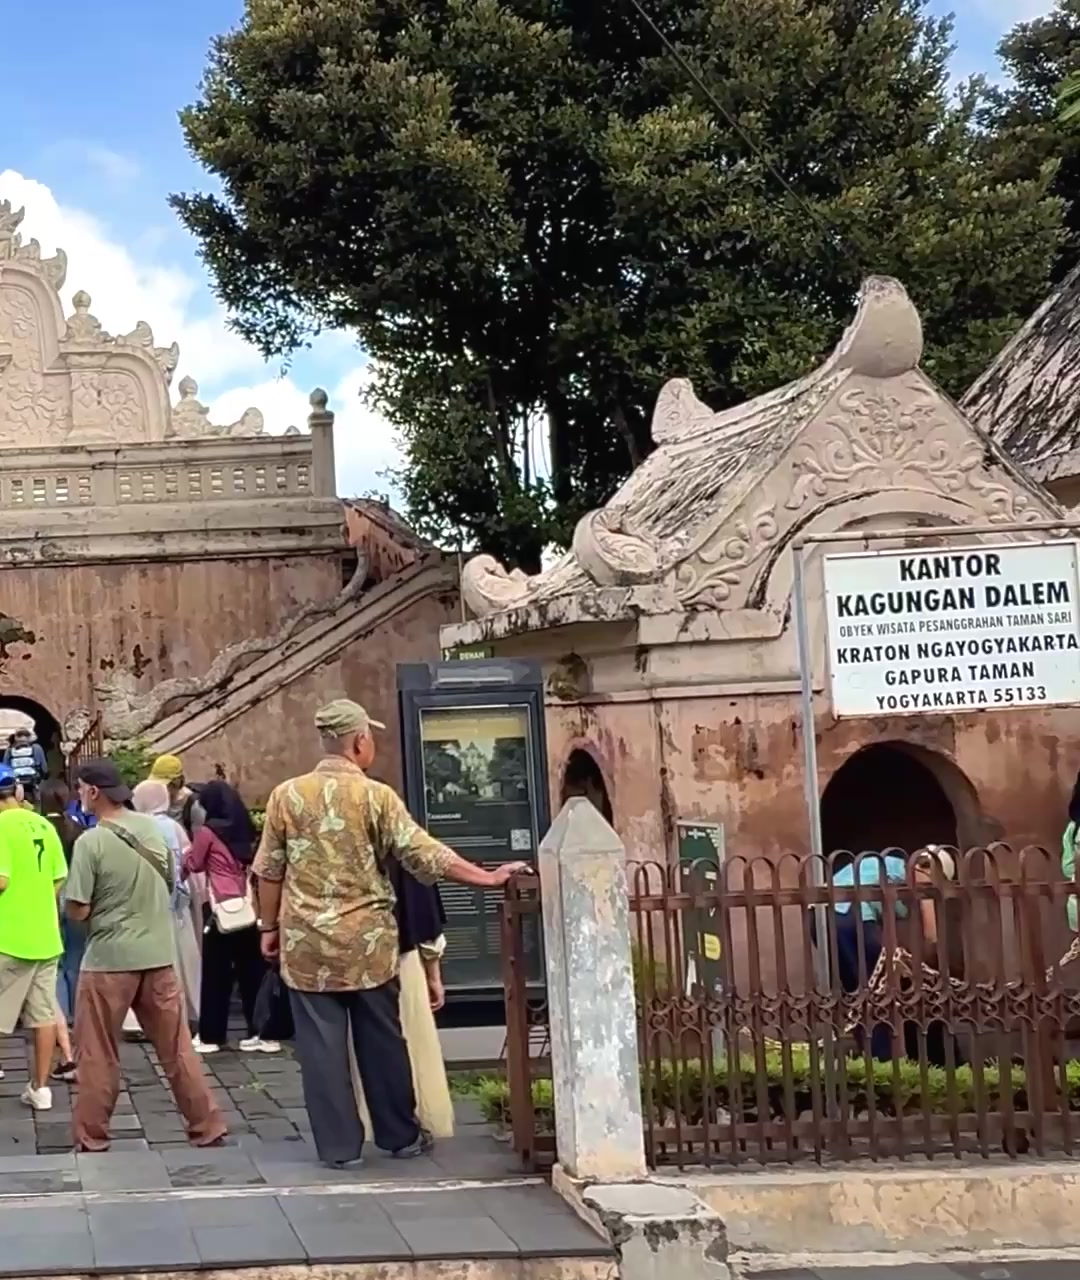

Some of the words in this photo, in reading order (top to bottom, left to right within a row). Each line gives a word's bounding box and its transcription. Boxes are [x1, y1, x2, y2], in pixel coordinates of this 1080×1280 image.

[900, 553, 1002, 581] KANTOR
[836, 587, 976, 618] KAGUNGAN
[985, 580, 1071, 608] DALEM
[839, 624, 874, 638] OBYEK
[877, 620, 916, 635] WISATA
[919, 615, 1004, 633] PESANGGRAHAN
[1006, 613, 1045, 627] TAMAN
[1047, 610, 1072, 624] SARI
[837, 644, 910, 664] KRATON
[917, 633, 1079, 659] NGAYOGYAKARTA
[885, 666, 962, 686] GAPURA
[968, 661, 1035, 681] TAMAN
[876, 689, 988, 710] YOGYAKARTA
[993, 685, 1047, 703] 55133
[33, 838, 45, 872] 7
